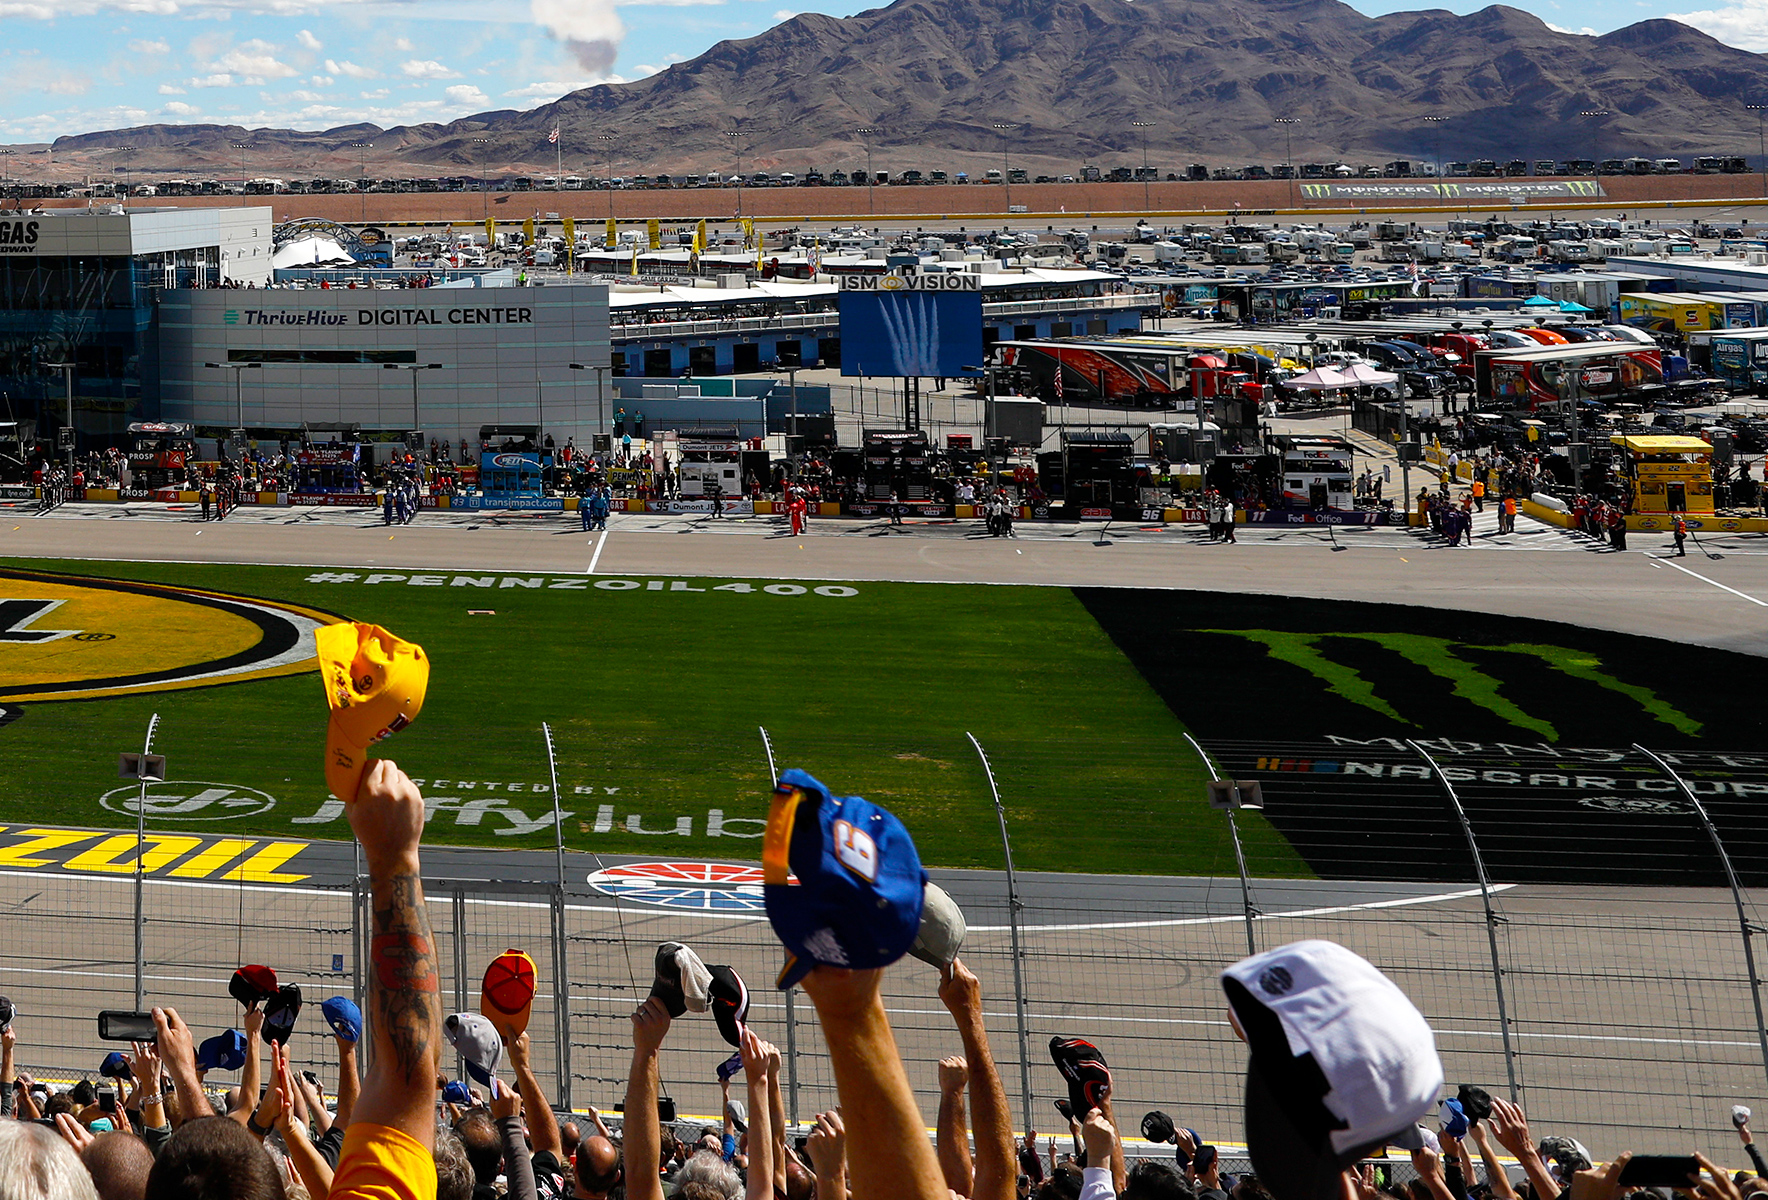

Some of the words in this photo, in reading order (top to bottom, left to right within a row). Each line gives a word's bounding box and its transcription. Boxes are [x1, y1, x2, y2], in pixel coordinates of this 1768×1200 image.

[1336, 184, 1430, 193] MONSTER
[1465, 183, 1563, 192] MONSTER
[841, 277, 877, 290] ISM
[905, 276, 978, 290] VISION
[1185, 289, 1209, 303] Airgas
[1477, 287, 1501, 295] GOODYEAR
[244, 310, 348, 326] ThriveHive
[359, 309, 442, 325] DIGITAL
[447, 308, 532, 325] CENTER
[1716, 343, 1744, 353] Airgas
[893, 457, 902, 465] 2
[452, 499, 464, 507] 43
[484, 498, 562, 509] transimpact.com
[656, 501, 670, 512] 95
[673, 503, 704, 511] Dumont
[706, 503, 725, 511] JES
[1080, 508, 1112, 517] GBR
[1141, 509, 1160, 520] 96
[1185, 510, 1202, 520] LAS
[1252, 511, 1266, 521] 11
[1288, 514, 1315, 523] FedEx
[1315, 514, 1342, 523] Office
[1363, 513, 1378, 523] 11
[304, 571, 860, 598] #PENNZOIL400
[1344, 761, 1616, 790] NASCAR
[575, 786, 621, 796] BY
[593, 803, 768, 838] lub
[833, 818, 879, 884] 6
